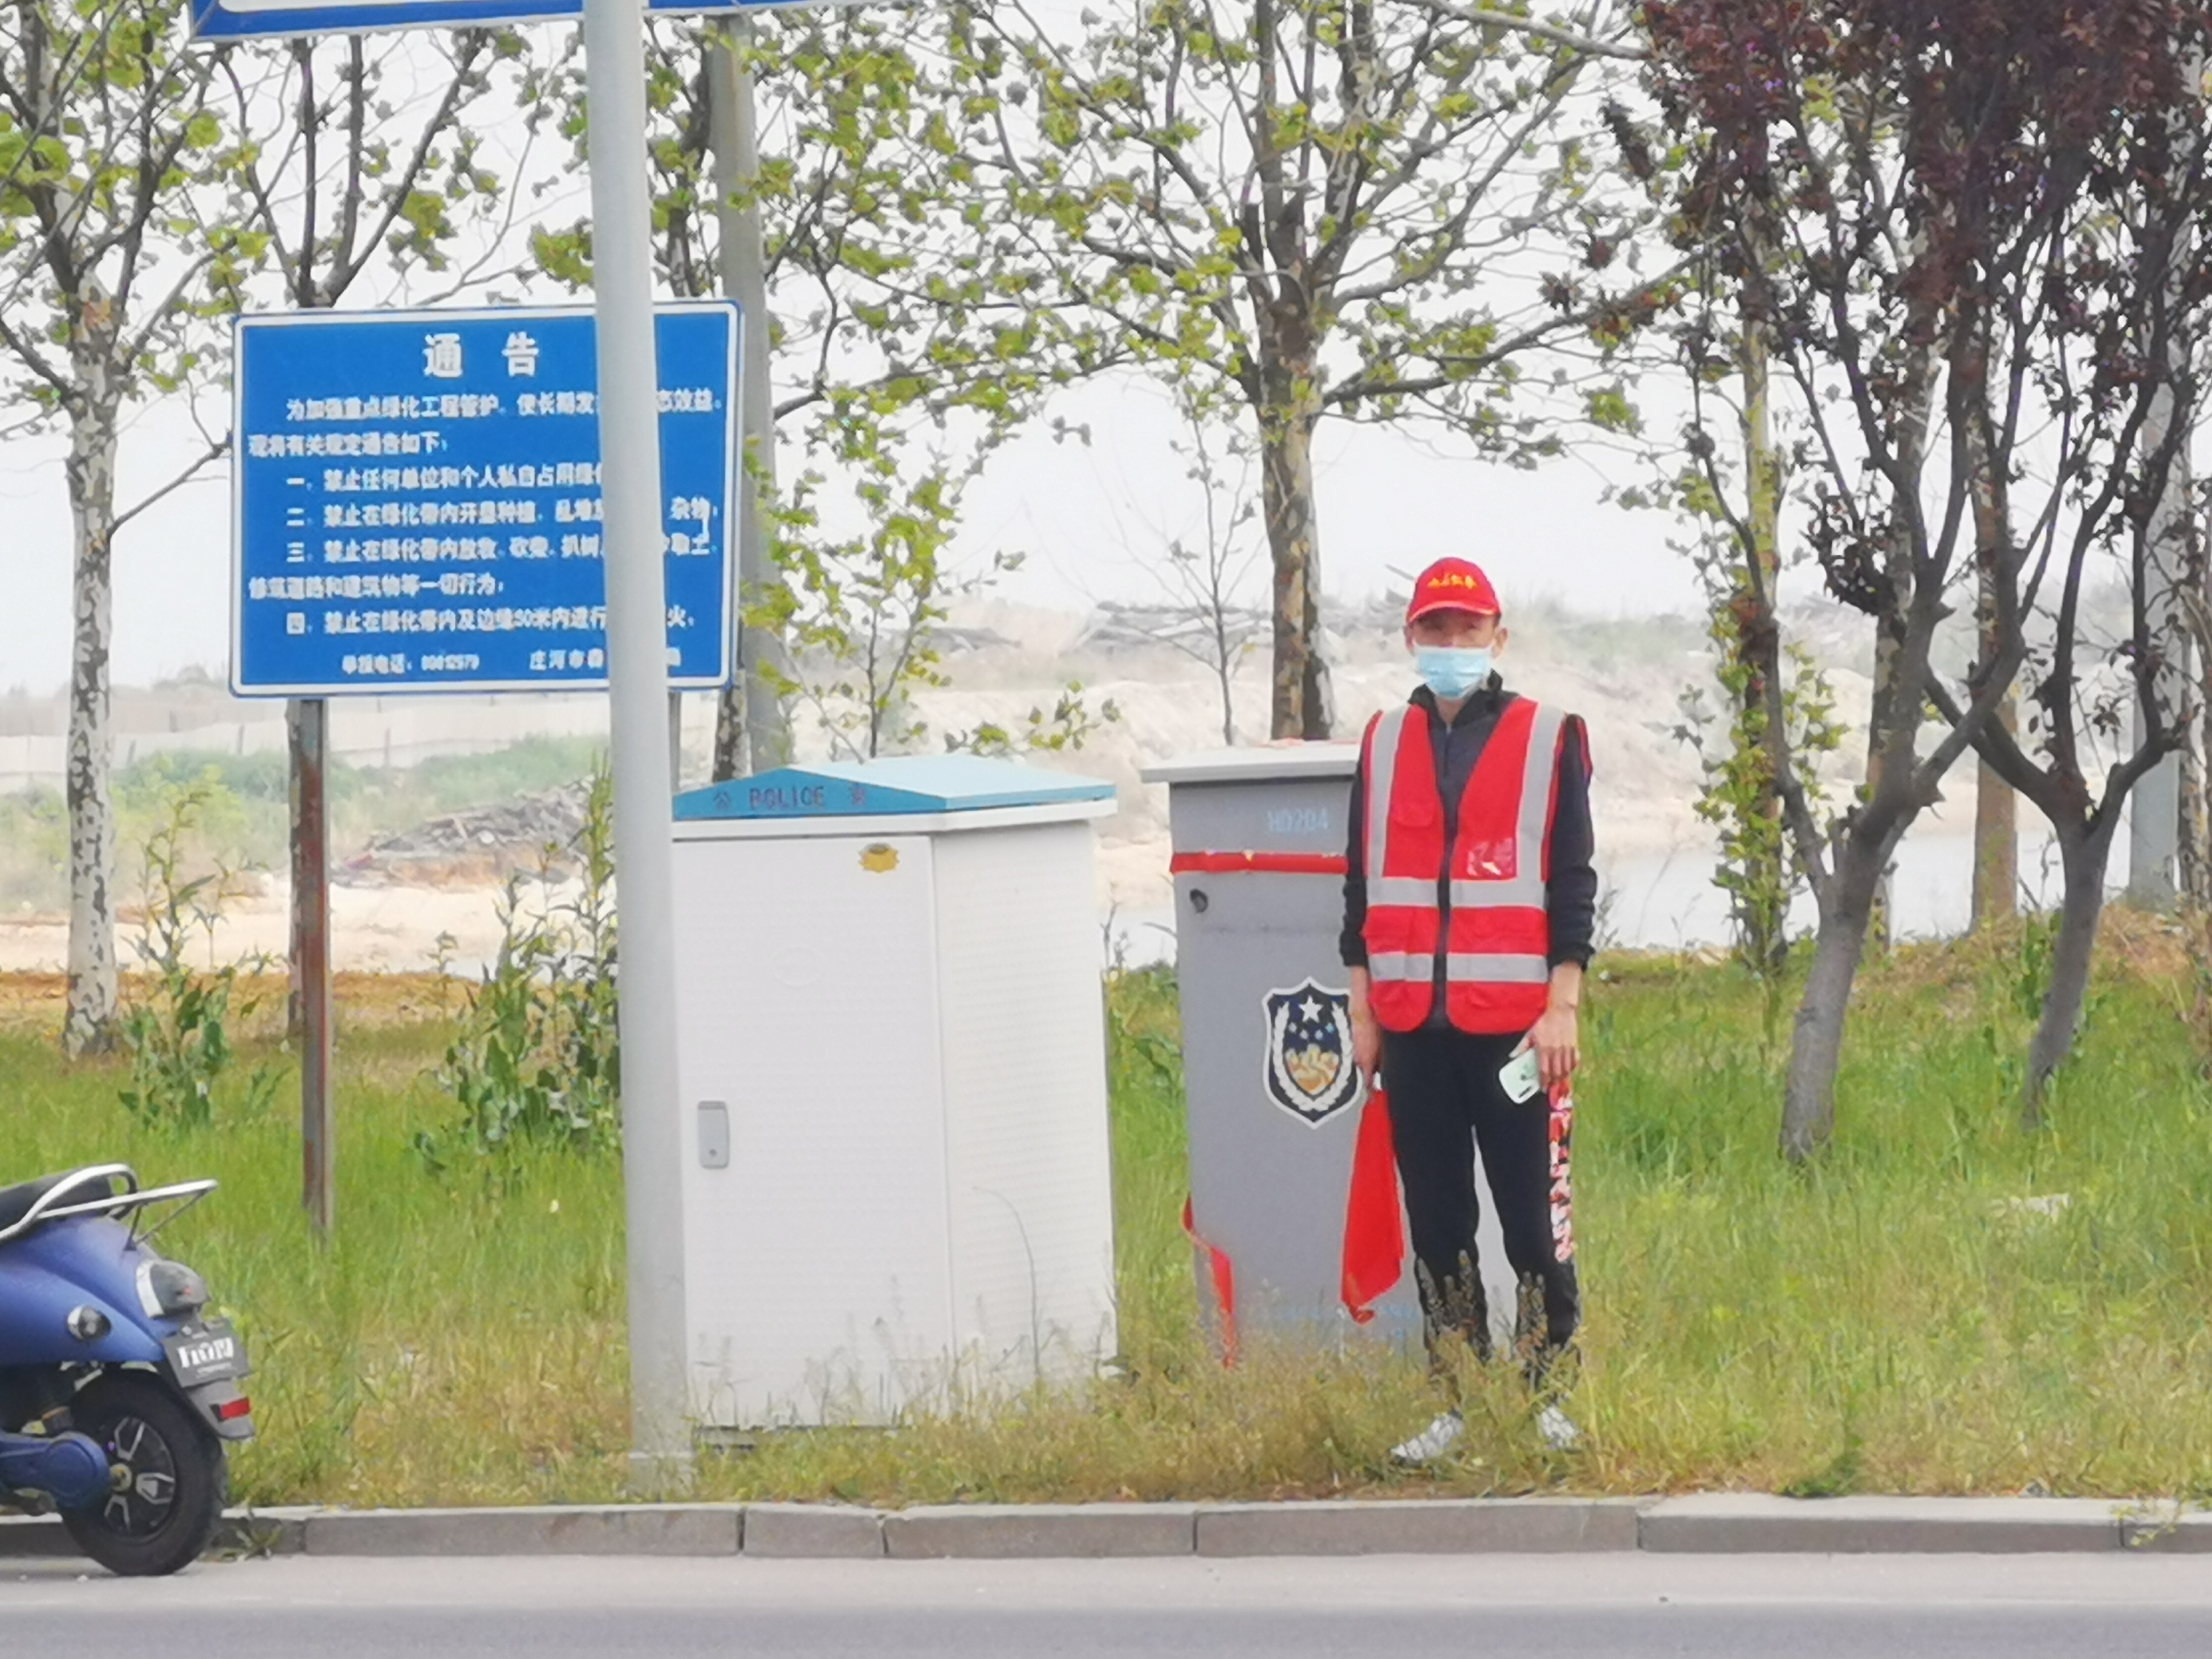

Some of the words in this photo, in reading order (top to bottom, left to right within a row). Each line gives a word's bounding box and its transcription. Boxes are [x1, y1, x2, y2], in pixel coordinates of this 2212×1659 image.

[286, 462, 602, 492] 一、禁止任何单位和个人私自占用绿
[750, 786, 825, 809] POLICE
